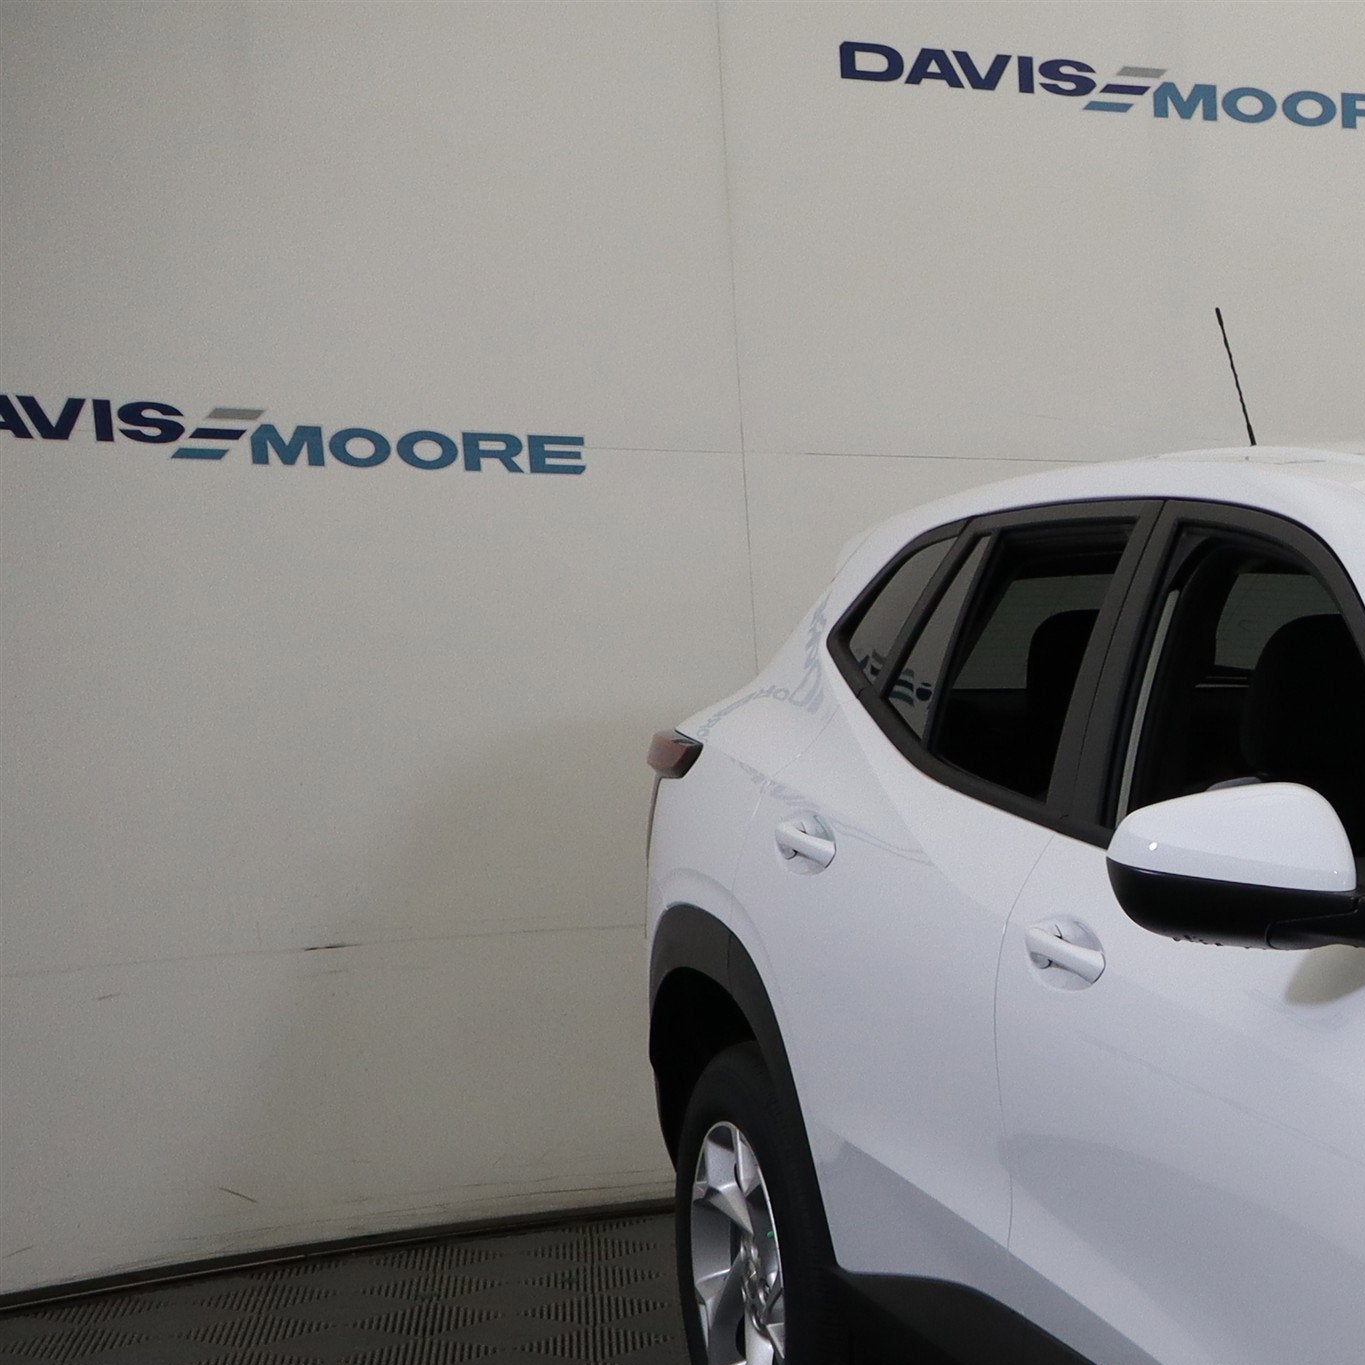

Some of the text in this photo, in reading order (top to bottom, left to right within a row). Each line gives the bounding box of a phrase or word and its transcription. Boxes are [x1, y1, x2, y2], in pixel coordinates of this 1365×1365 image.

[839, 41, 1097, 97] DAVIS
[0, 395, 587, 475] VIS MOORE
